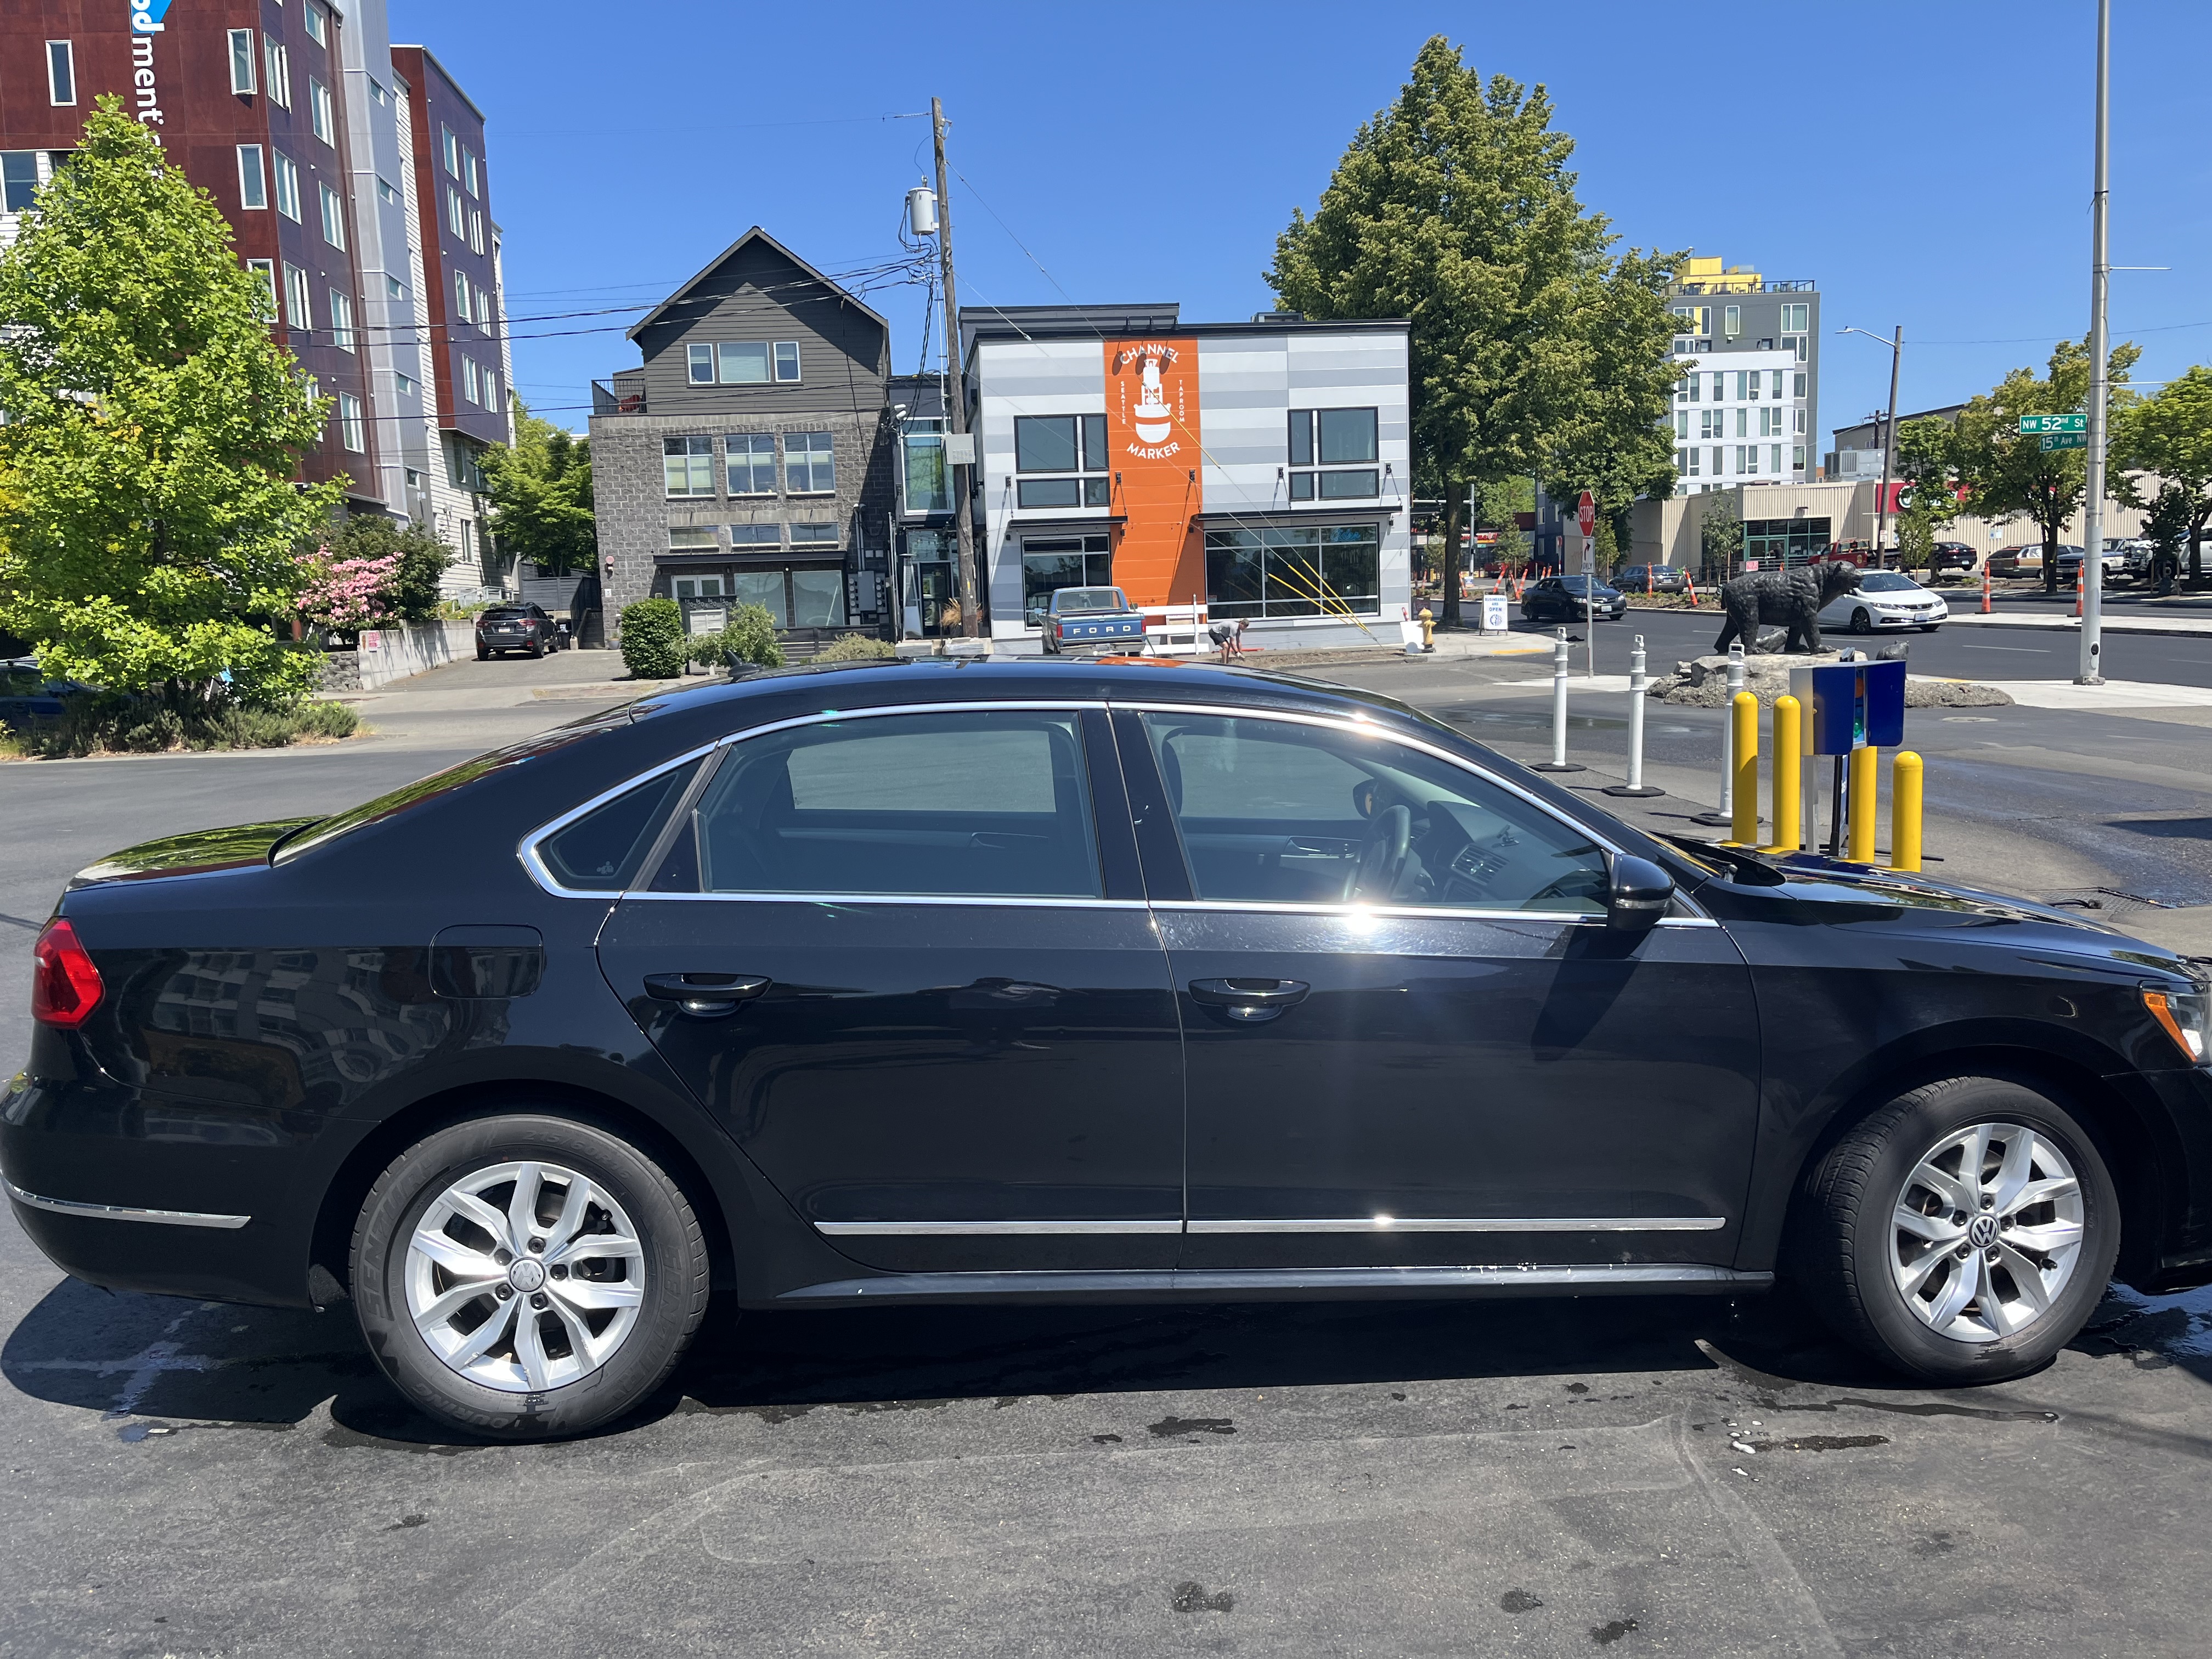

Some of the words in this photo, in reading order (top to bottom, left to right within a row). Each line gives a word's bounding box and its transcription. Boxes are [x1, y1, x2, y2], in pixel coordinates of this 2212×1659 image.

[1120, 343, 1179, 364] CHANNEL
[2023, 420, 2037, 429] NW
[2041, 416, 2069, 431] 52nd
[2074, 418, 2084, 427] St
[2061, 437, 2073, 445] Ave
[2076, 433, 2087, 443] NW
[1126, 442, 1181, 459] MARKER
[1579, 506, 1593, 522] STOP
[685, 599, 696, 609] 1502
[696, 598, 708, 608] 1504
[1073, 625, 1131, 635] FORD
[523, 1130, 632, 1180] 215/60R16
[413, 1383, 525, 1429] TOURING
